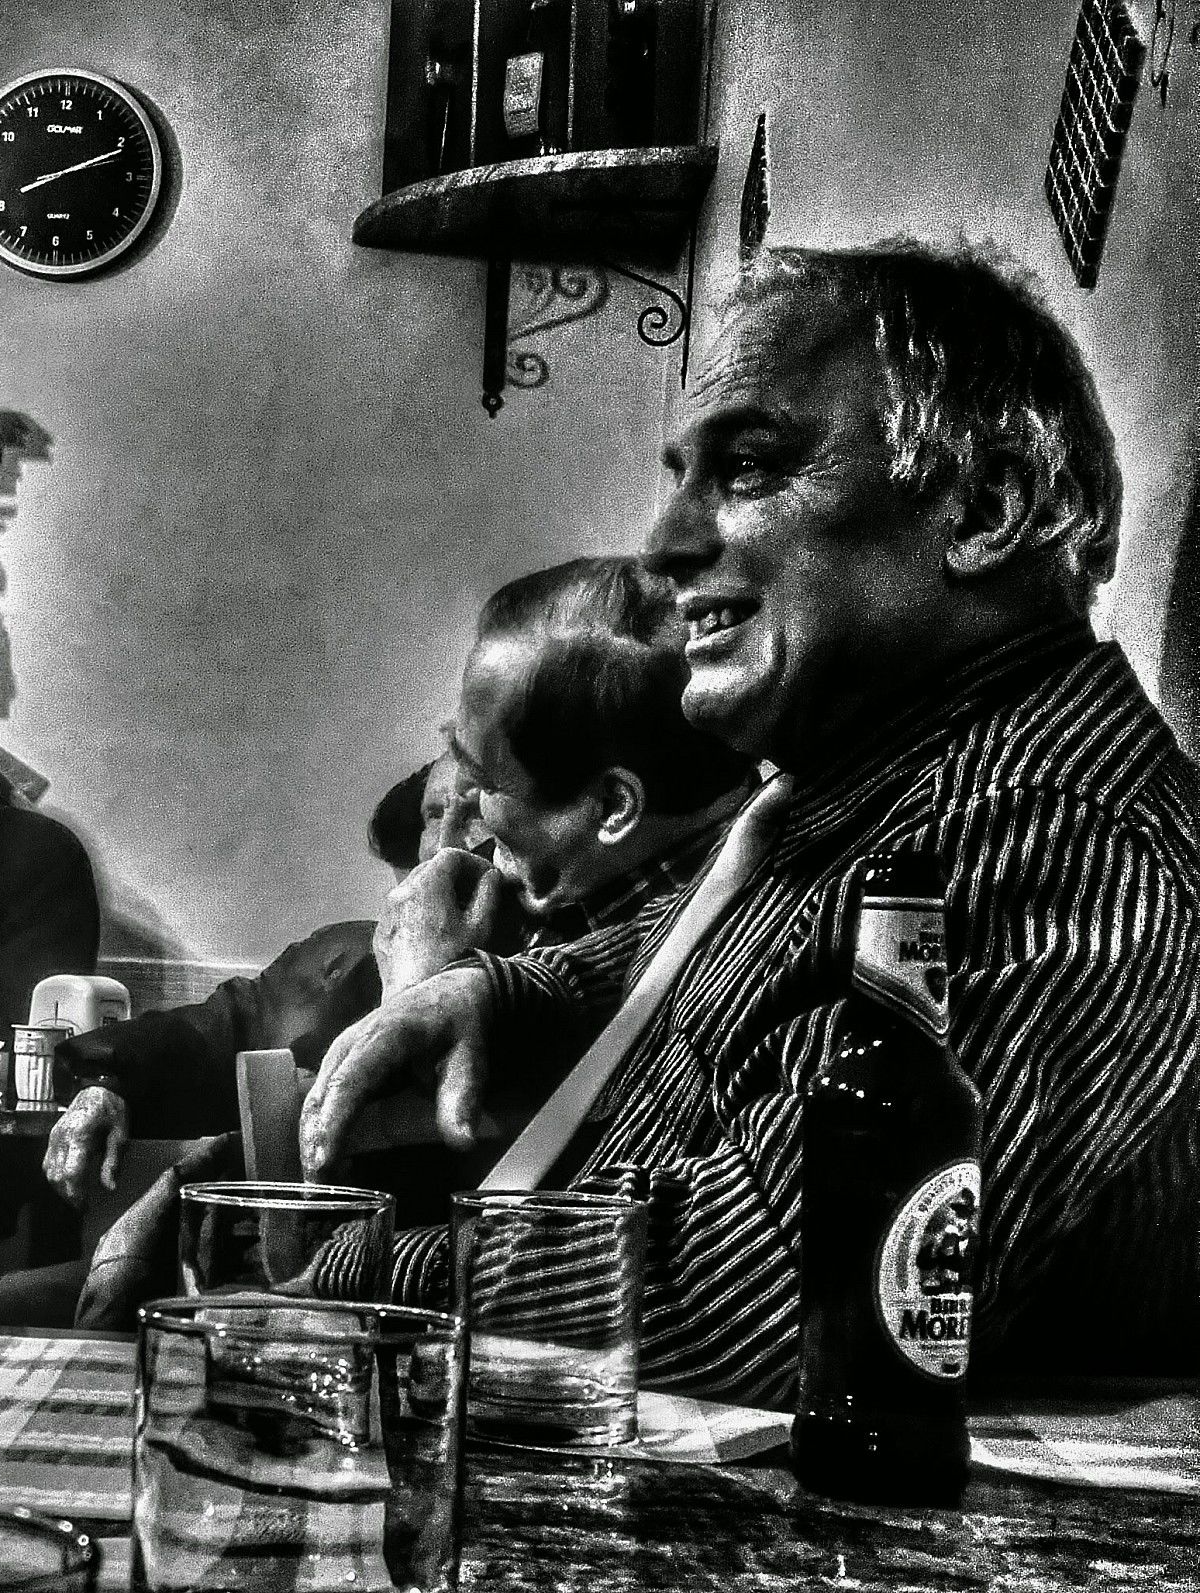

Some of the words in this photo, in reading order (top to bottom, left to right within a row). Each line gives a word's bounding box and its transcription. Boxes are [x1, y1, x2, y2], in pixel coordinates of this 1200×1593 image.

[60, 99, 73, 111] 12
[26, 106, 39, 118] 11
[97, 110, 103, 121] 1
[2, 131, 15, 142] 10
[117, 136, 125, 147] 2
[125, 172, 133, 182] 3
[112, 207, 120, 218] 4
[19, 226, 28, 237] 7
[86, 230, 94, 241] 5
[52, 236, 60, 247] 6
